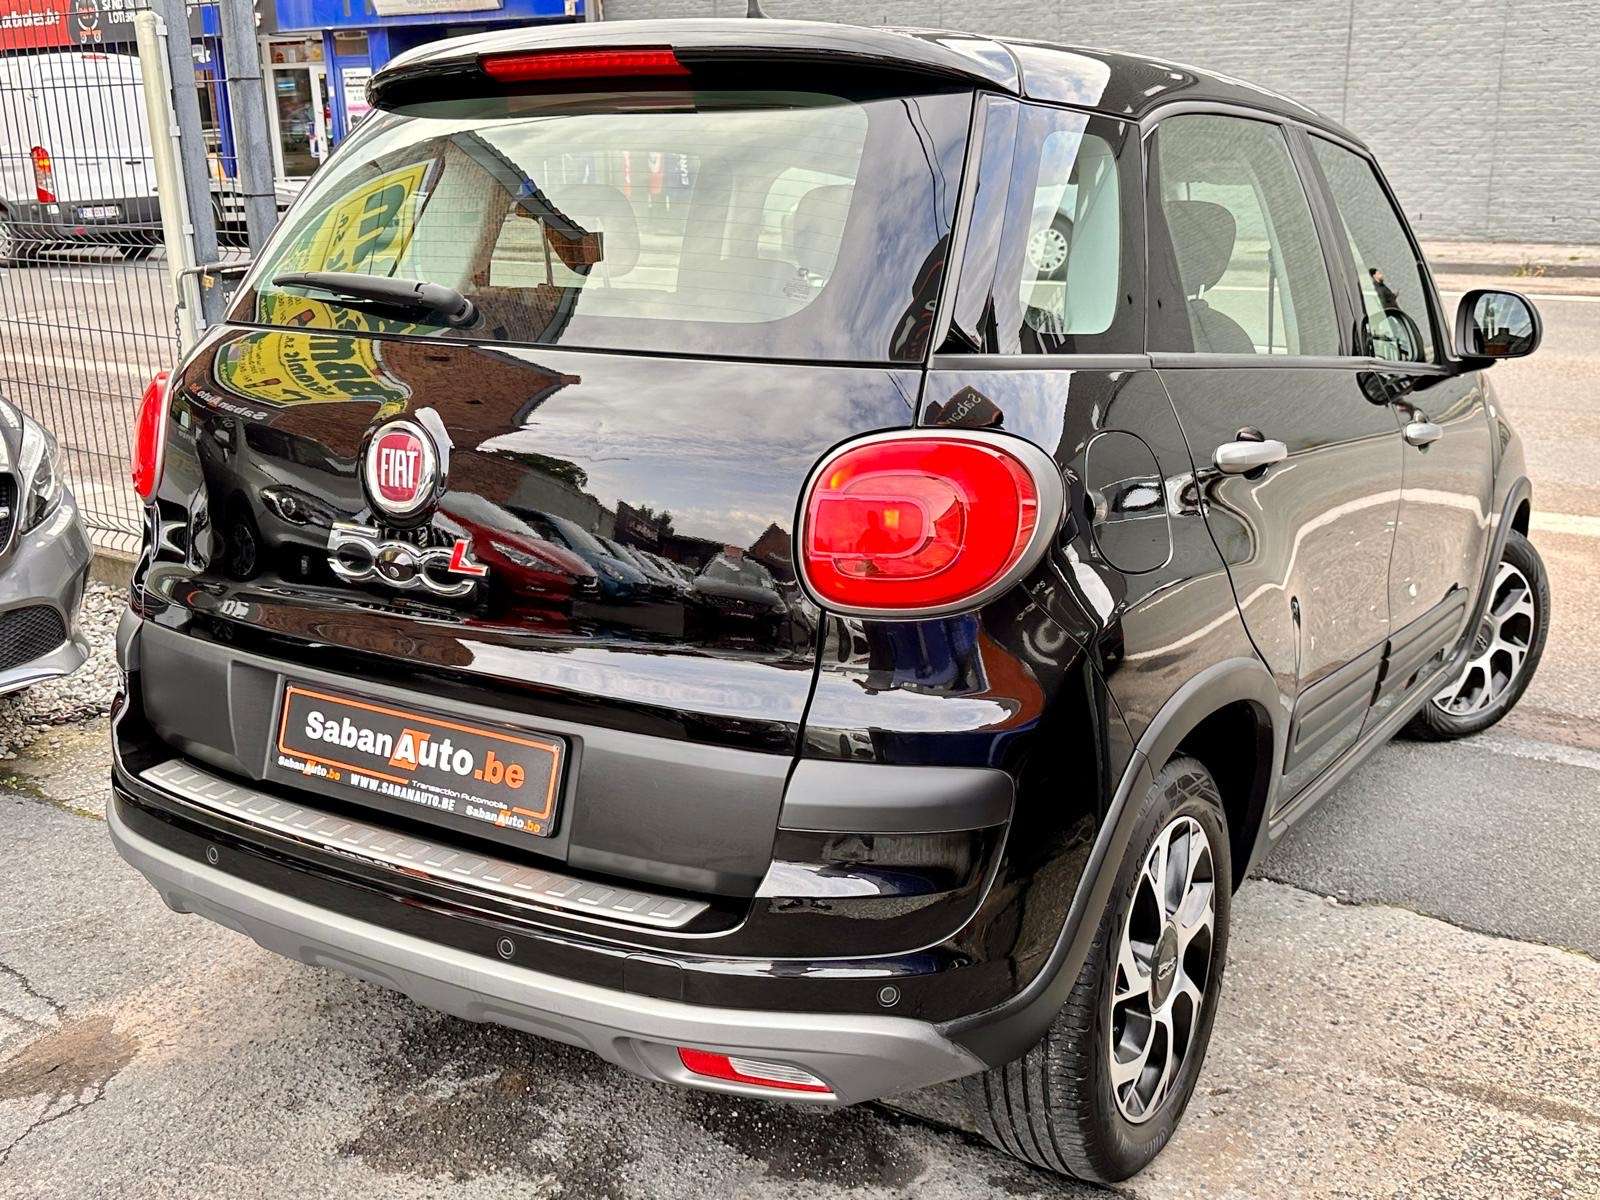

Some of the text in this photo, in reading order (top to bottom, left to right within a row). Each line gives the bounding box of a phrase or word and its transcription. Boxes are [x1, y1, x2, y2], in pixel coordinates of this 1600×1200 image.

[380, 447, 419, 491] FIAT
[305, 710, 526, 789] SabanAuto.be
[277, 756, 341, 782] SabanAuto.be
[350, 773, 456, 812] WWW.SABANAUTO.BE
[411, 779, 508, 810] Transaction Automobile
[465, 804, 541, 833] SabanAuto.be
